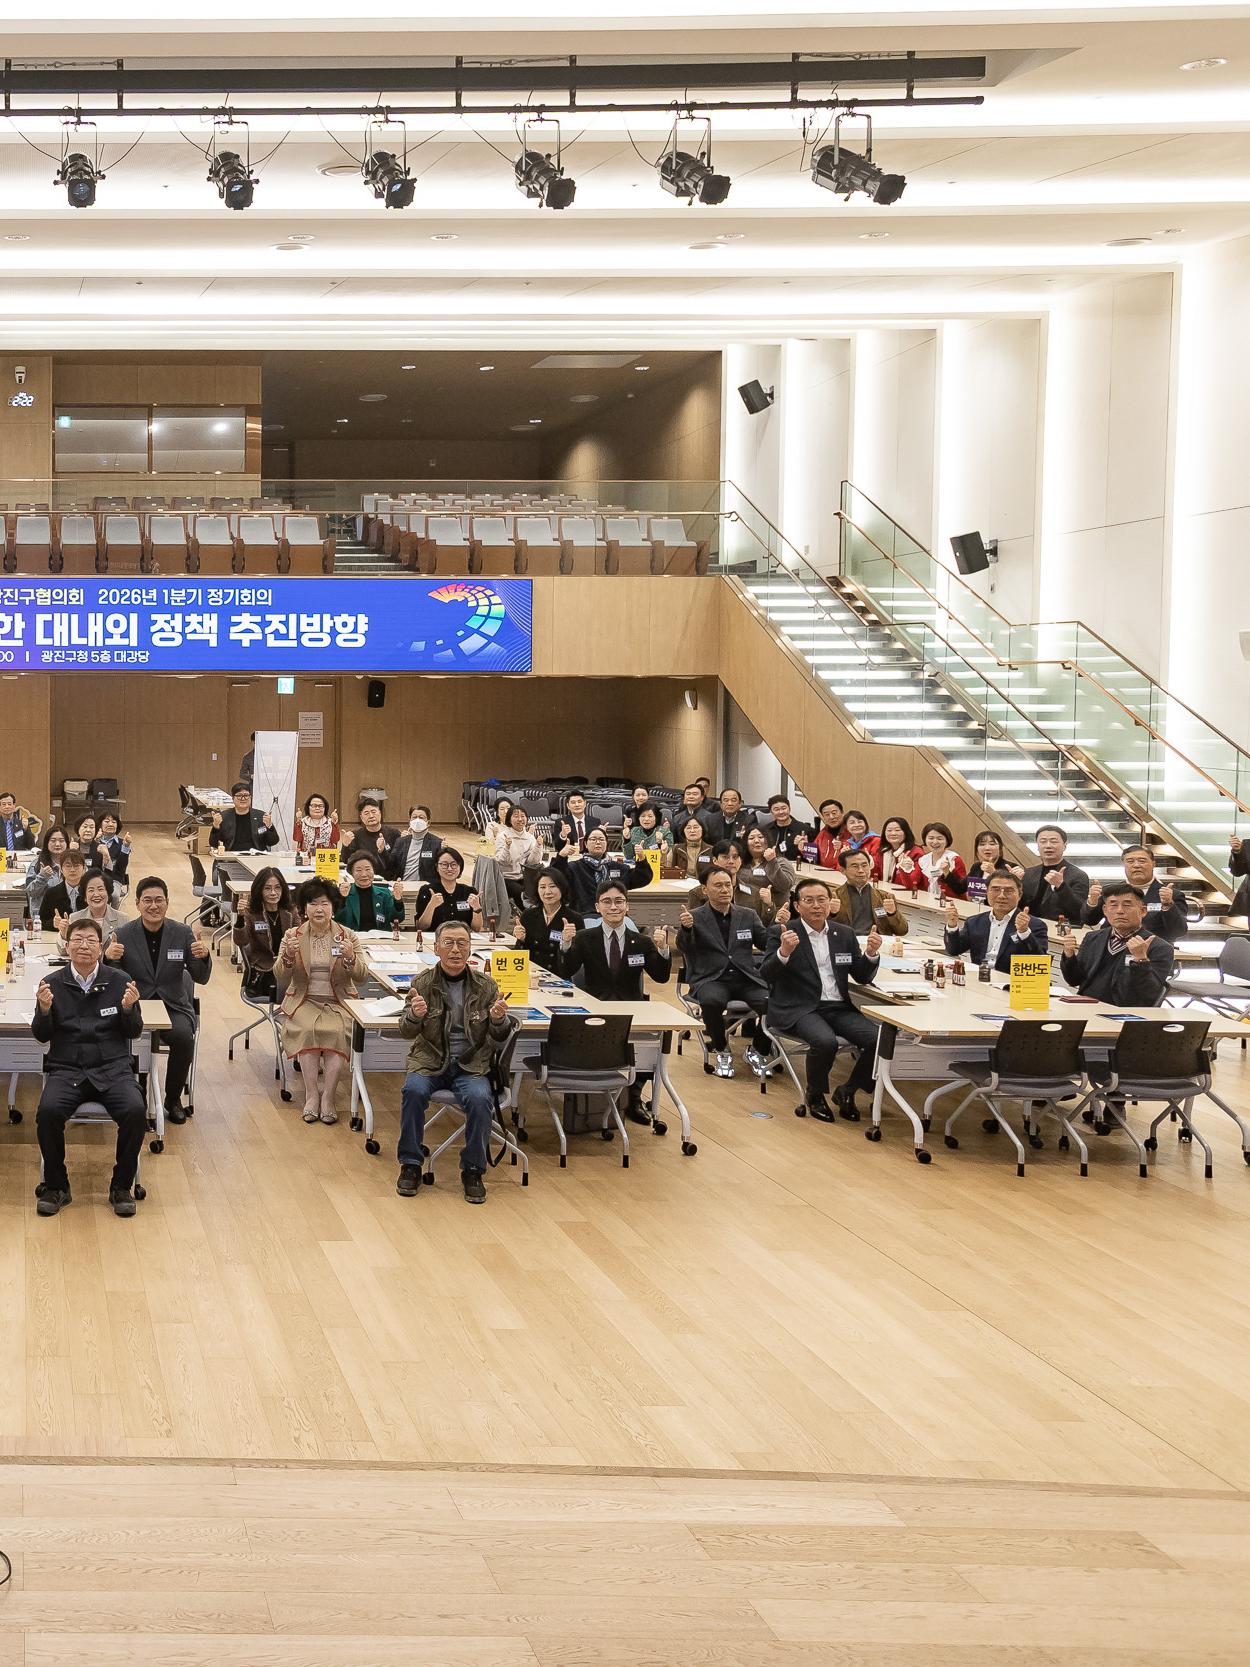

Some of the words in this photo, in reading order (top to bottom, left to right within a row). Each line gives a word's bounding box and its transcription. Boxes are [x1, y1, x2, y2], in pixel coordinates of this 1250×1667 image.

[98, 588, 158, 606] 2026년
[162, 588, 202, 606] 1분기
[207, 588, 272, 606] 정기회의
[35, 612, 138, 647] 대내외
[150, 612, 218, 647] 정책
[229, 612, 369, 648] 추진방향
[40, 650, 89, 663] 광진구청
[91, 650, 111, 663] 5층
[114, 650, 150, 663] 대강당
[496, 957, 524, 971] 번영
[1012, 963, 1048, 976] 한반도
